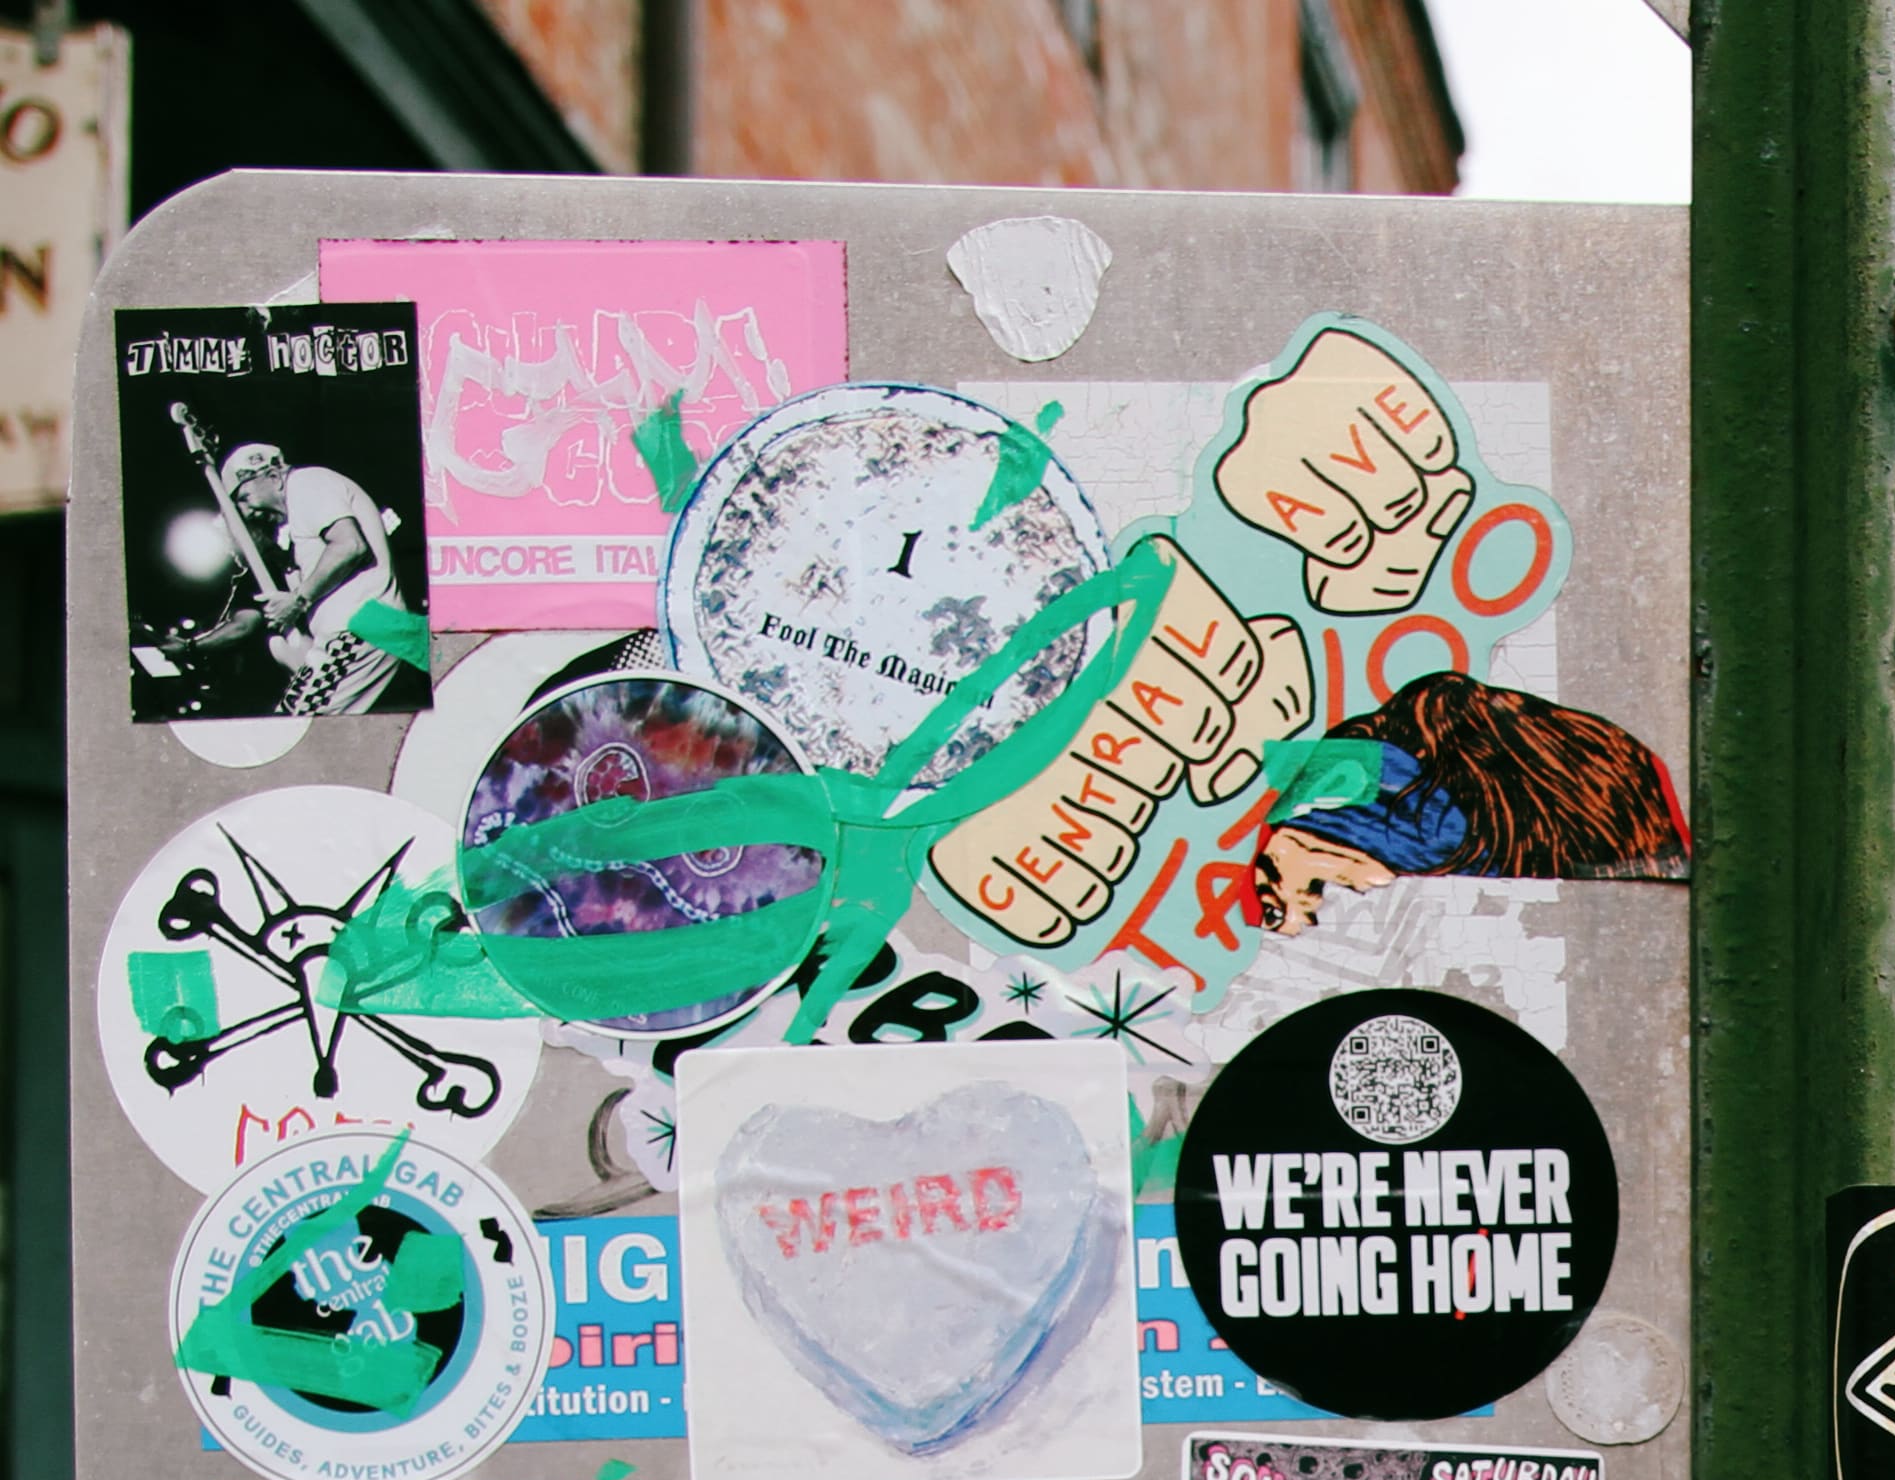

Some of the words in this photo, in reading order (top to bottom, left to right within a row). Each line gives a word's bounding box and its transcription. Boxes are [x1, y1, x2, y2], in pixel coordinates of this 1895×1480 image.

[1266, 386, 1431, 533] AVE
[758, 612, 817, 651] Fool
[823, 634, 872, 669] The
[978, 621, 1220, 913] CENTRAL
[394, 1158, 464, 1208] GAB
[757, 1166, 1026, 1260] WEIRD
[1212, 1151, 1391, 1230] WE'RE
[1403, 1148, 1572, 1227] NEVER
[291, 1234, 383, 1299] the
[1219, 1236, 1398, 1317] GOING
[1410, 1232, 1573, 1314] HOME
[232, 1403, 310, 1472] GUIDES,
[464, 1380, 513, 1440] BITES
[509, 1275, 530, 1354] BOOZE
[1139, 1369, 1224, 1398] stem
